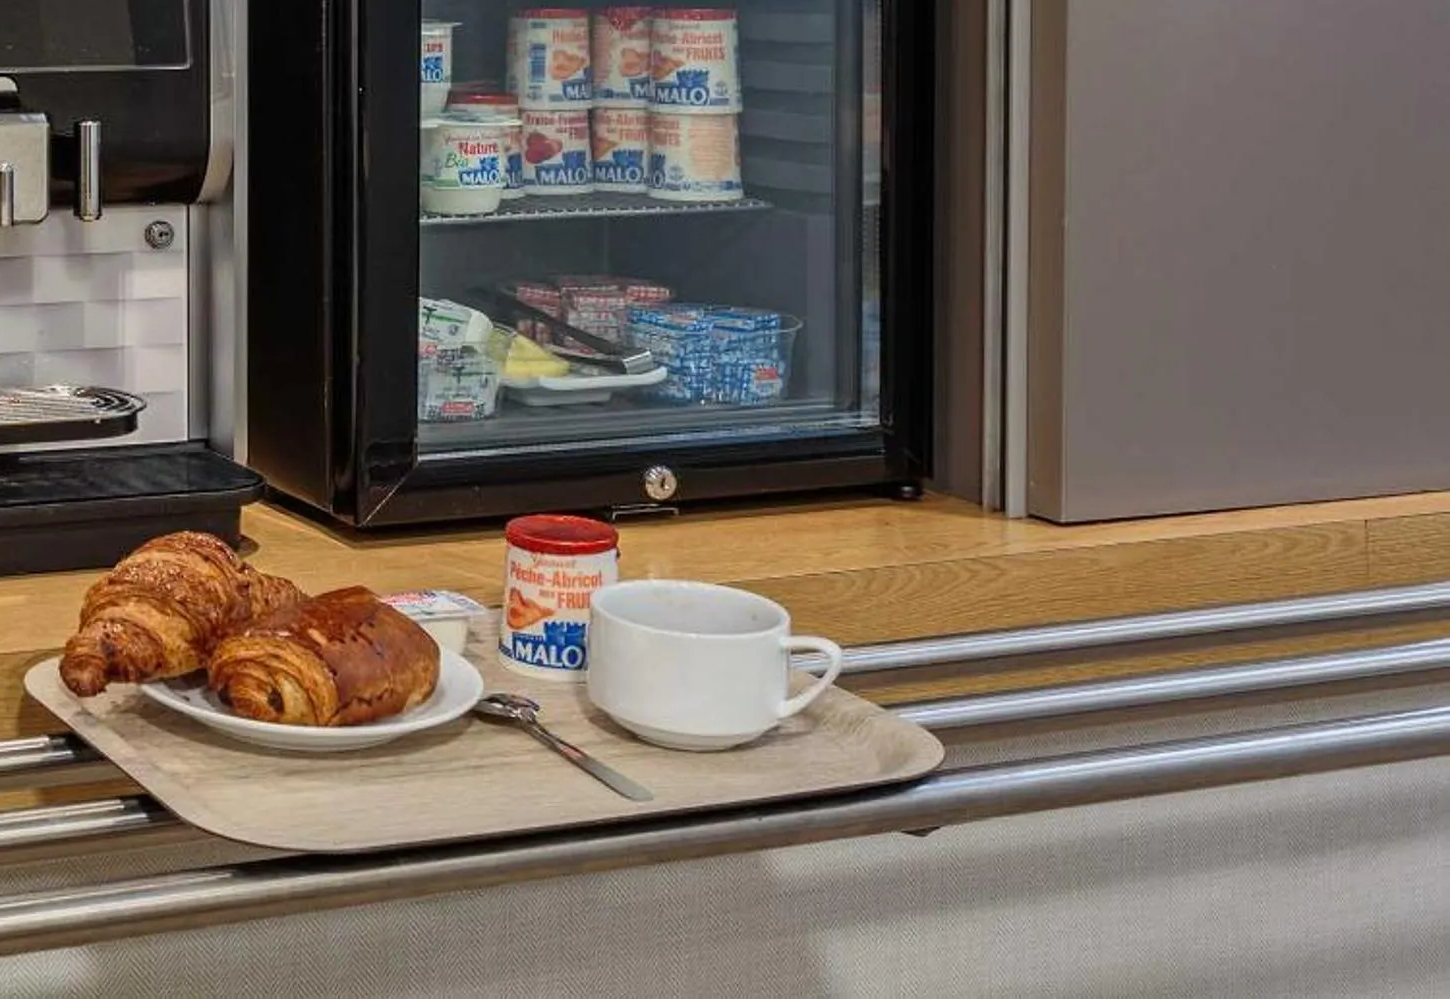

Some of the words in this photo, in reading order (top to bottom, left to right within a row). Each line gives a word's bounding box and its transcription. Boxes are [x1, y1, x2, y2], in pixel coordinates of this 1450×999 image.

[657, 86, 708, 106] MALO
[461, 168, 499, 185] MALO
[540, 167, 587, 184] MALO
[595, 166, 642, 182] MALO
[515, 640, 584, 668] MALO
